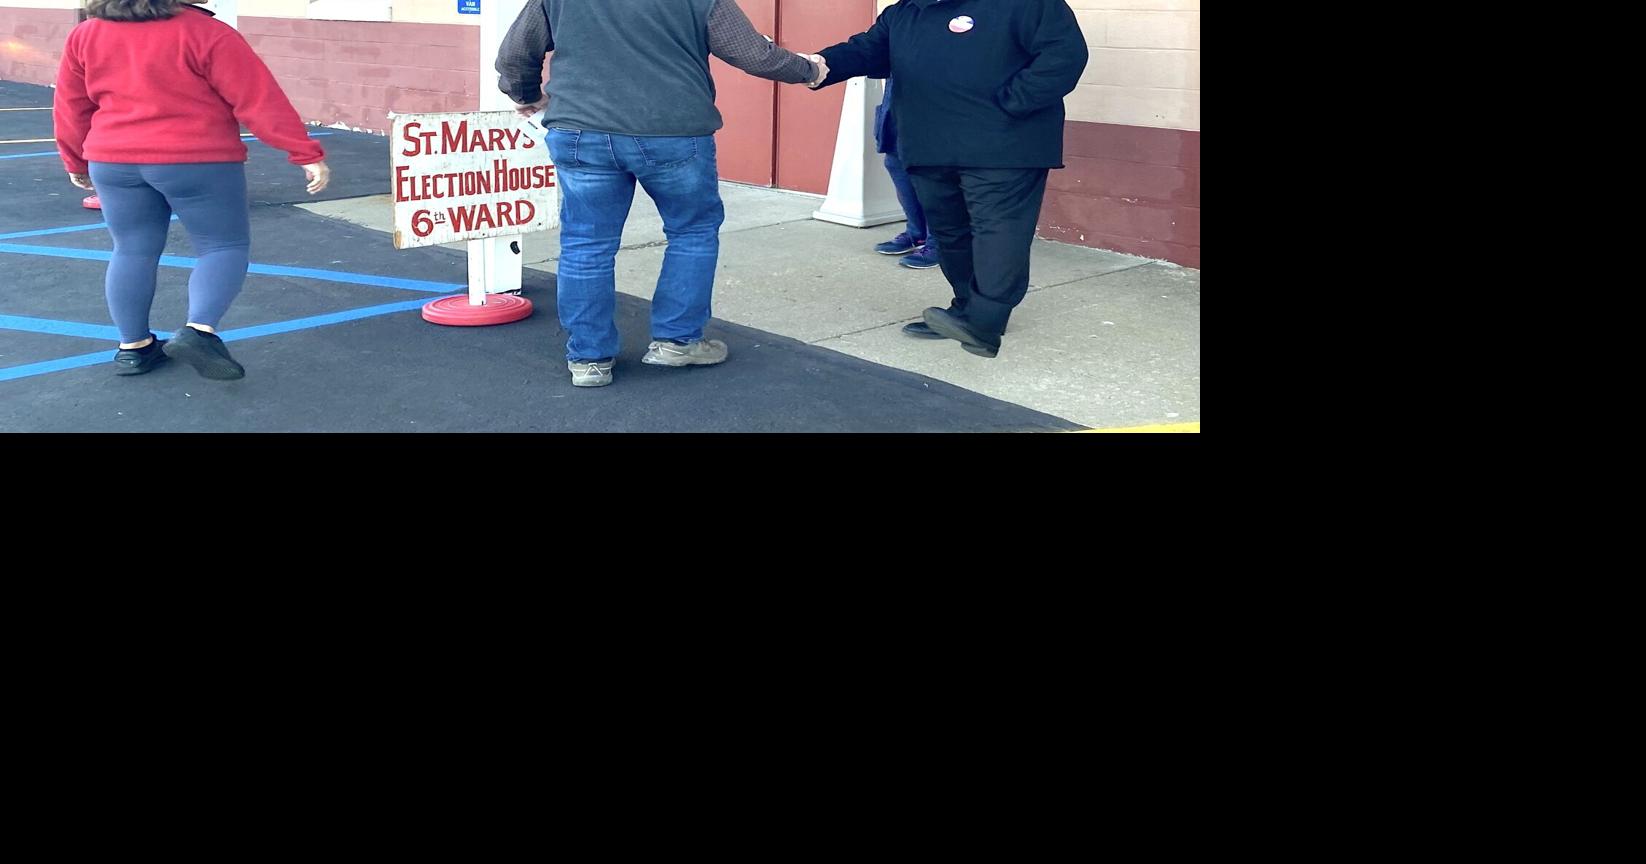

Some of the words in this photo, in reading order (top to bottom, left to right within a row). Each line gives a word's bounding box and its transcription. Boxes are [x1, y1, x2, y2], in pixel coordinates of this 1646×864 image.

[395, 164, 492, 203] ELECTION
[493, 158, 556, 193] HOUSE
[447, 199, 536, 233] WARD
